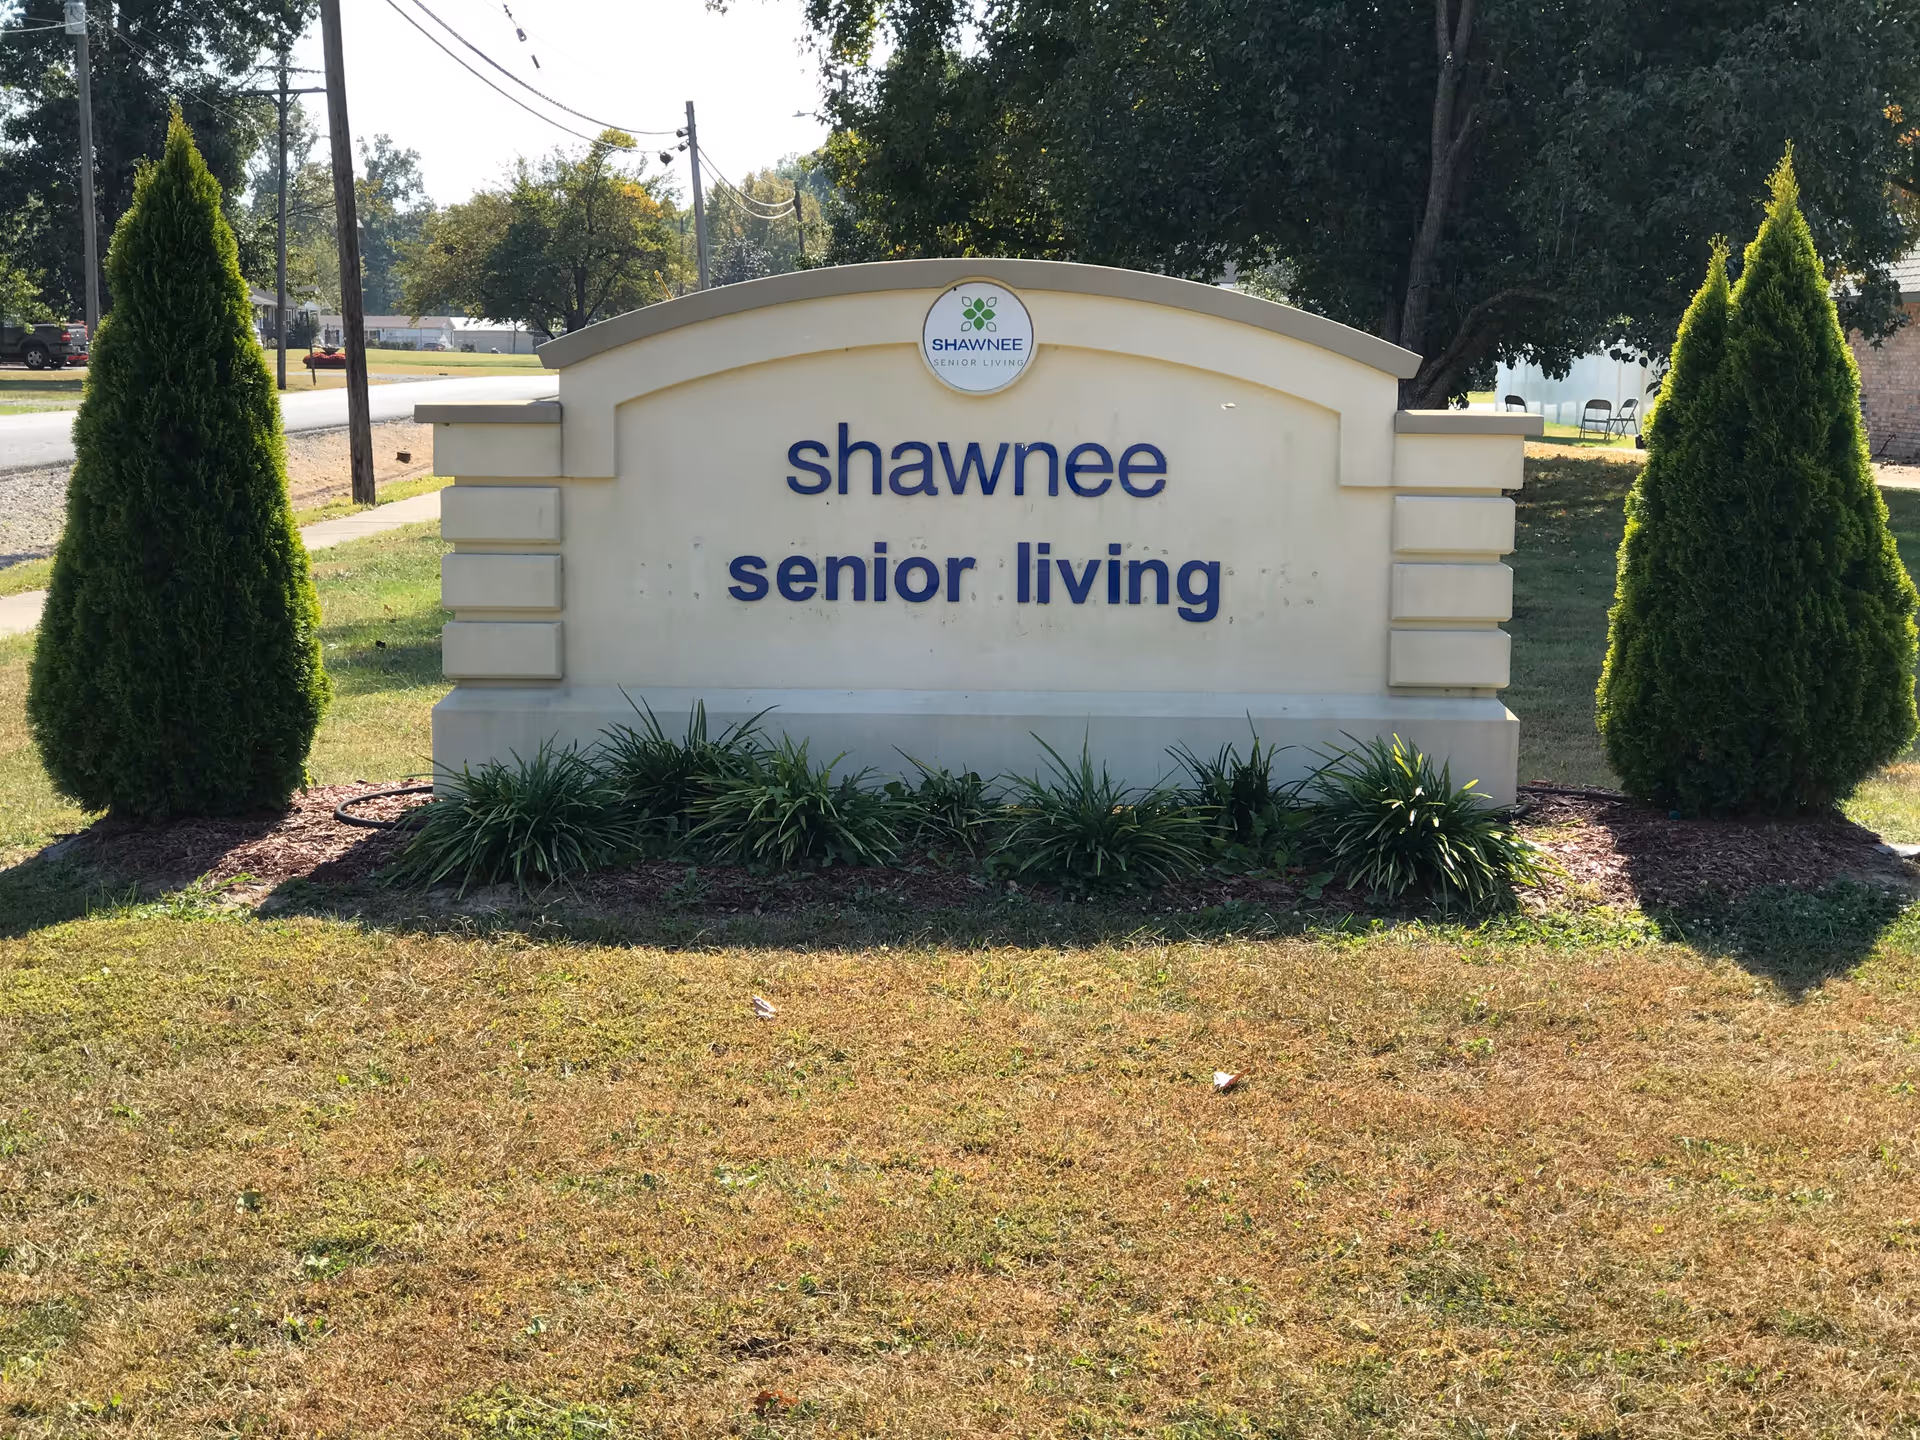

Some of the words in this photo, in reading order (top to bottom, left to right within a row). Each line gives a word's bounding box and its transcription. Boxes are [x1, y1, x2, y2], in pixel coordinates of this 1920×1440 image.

[932, 338, 1023, 352] SHAWNEE
[933, 358, 977, 367] SENIOR
[983, 358, 1025, 367] LIVING
[787, 423, 1168, 498] shawnee
[728, 541, 977, 603] senior
[1017, 541, 1221, 624] living
